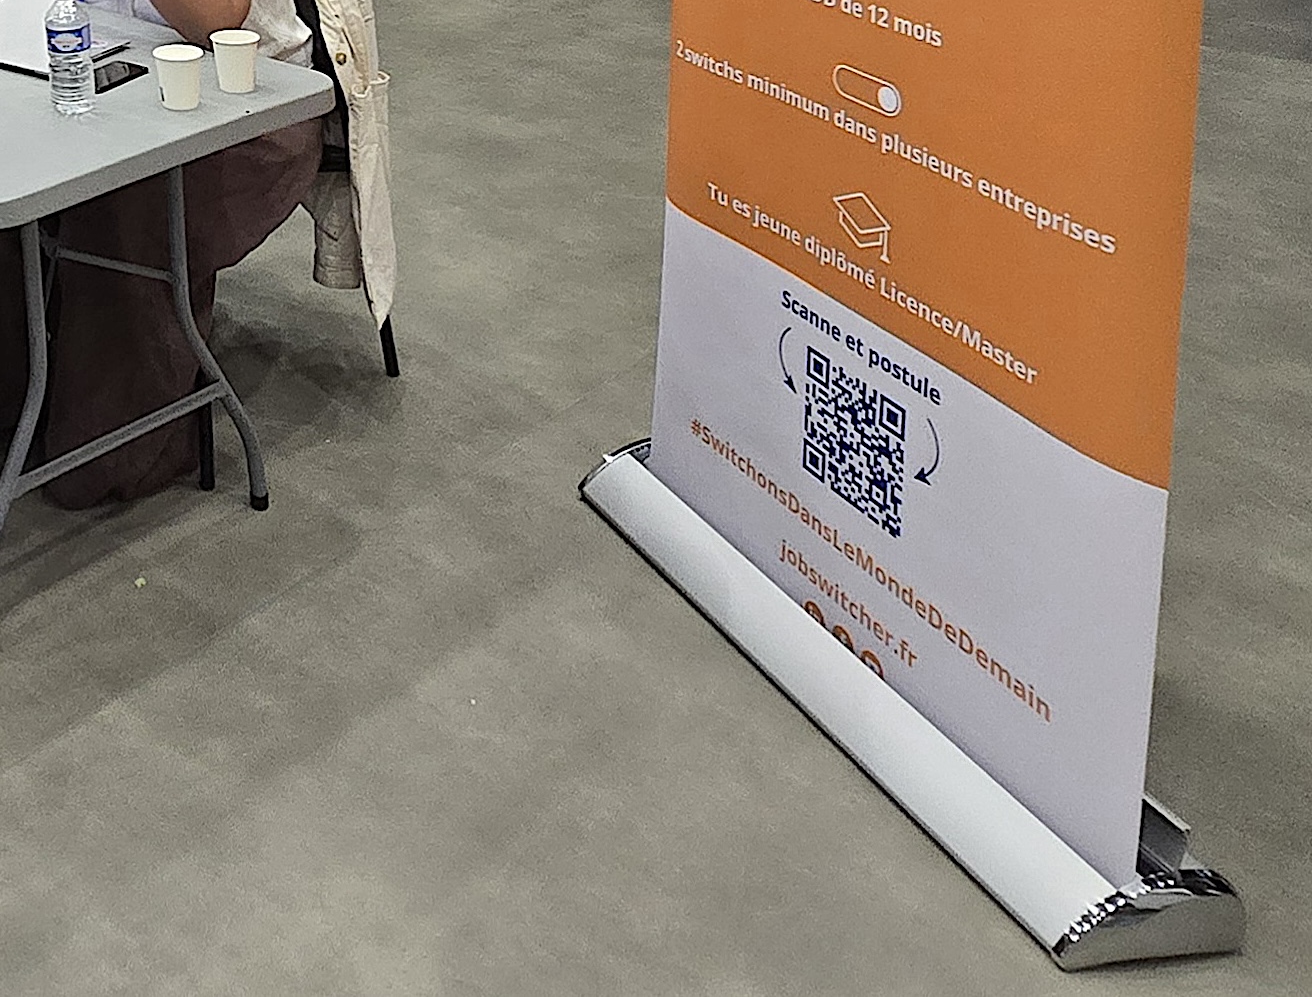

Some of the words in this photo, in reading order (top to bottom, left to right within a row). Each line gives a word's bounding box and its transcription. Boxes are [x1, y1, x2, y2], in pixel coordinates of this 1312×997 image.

[867, 3, 890, 29] 12
[893, 13, 942, 47] mois
[747, 72, 830, 121] minimum
[833, 109, 877, 144] dans
[881, 133, 974, 189] plusieurs
[977, 177, 1117, 255] entreprises
[707, 182, 728, 207] Tu
[732, 197, 751, 218] es
[751, 204, 801, 246] jeune
[804, 235, 876, 291] diplômé
[879, 276, 1039, 385] Licence/Master
[781, 290, 841, 342] Scanne
[845, 332, 864, 357] et
[868, 348, 942, 406] postule
[690, 418, 1052, 723] #SwitchonsDansLeMondeDeDemain
[778, 539, 919, 669] jobswitcher.fr
